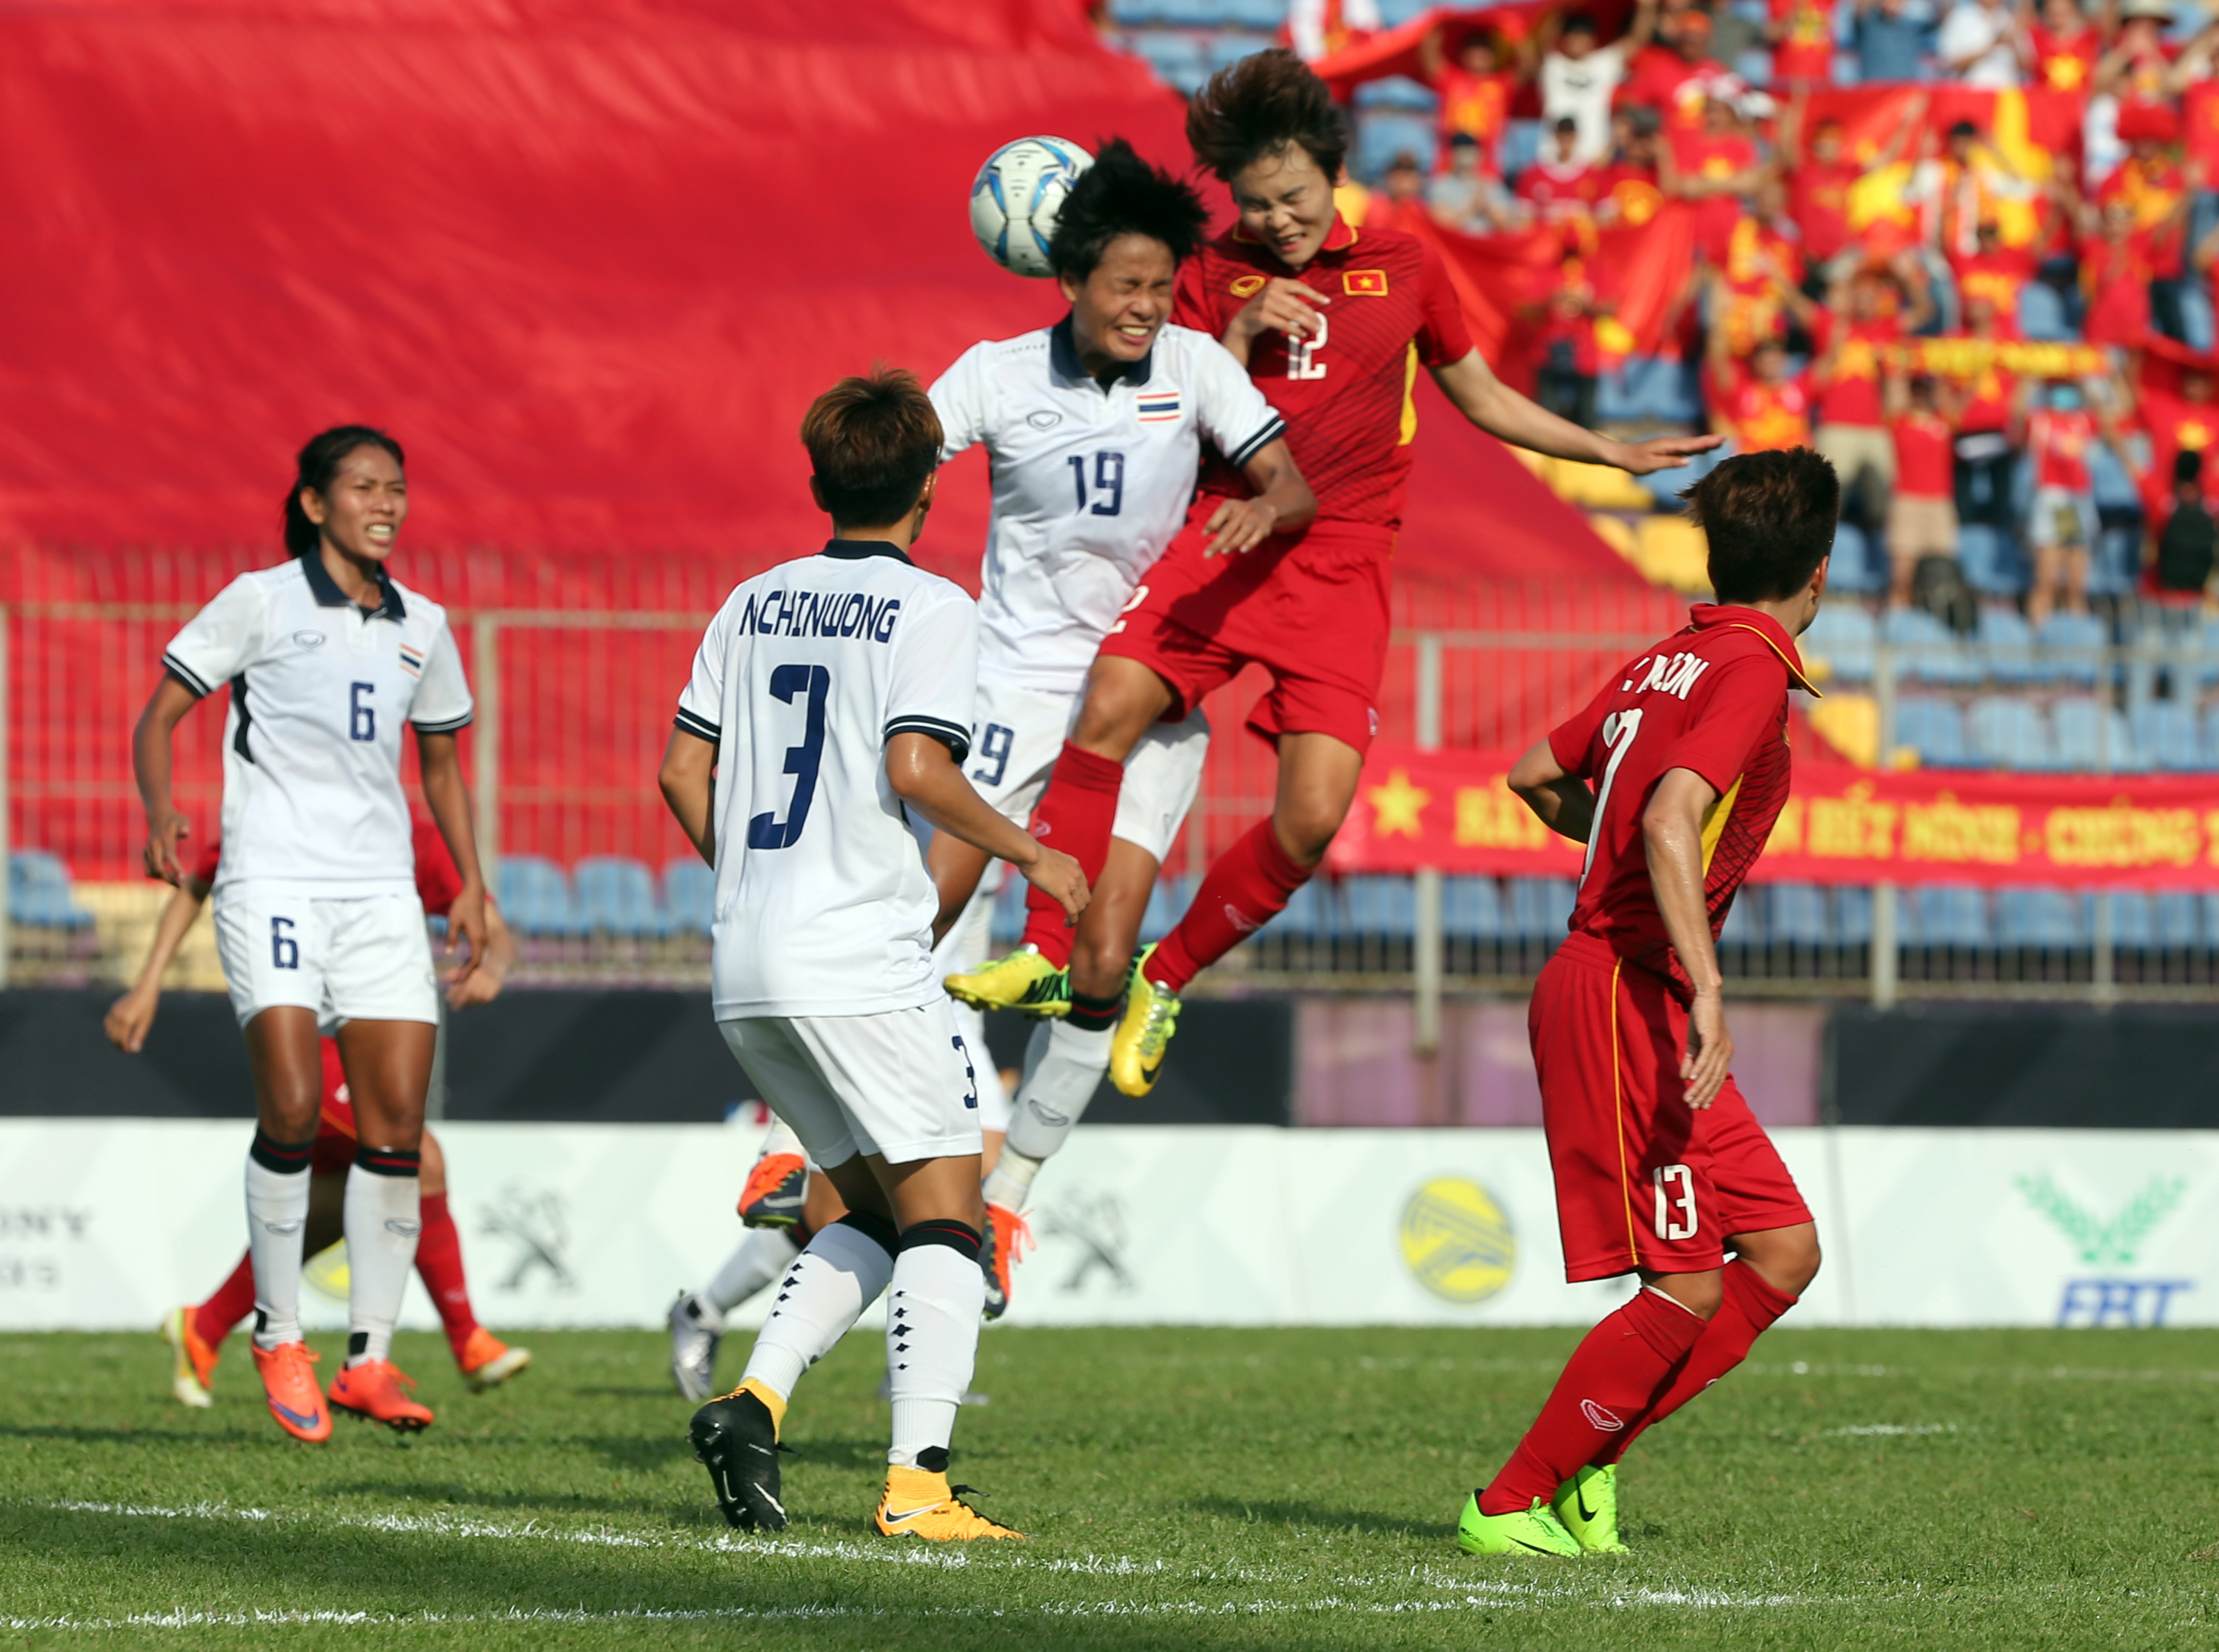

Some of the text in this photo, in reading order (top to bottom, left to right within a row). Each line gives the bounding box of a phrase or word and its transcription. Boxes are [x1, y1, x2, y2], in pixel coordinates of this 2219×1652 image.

[1287, 311, 1328, 381] 12
[1067, 452, 1124, 516] 19
[350, 681, 375, 742] 6
[747, 664, 830, 850] 3
[973, 721, 1015, 786] 9
[271, 916, 299, 969] 6
[952, 1035, 978, 1109] 3
[1652, 1163, 1698, 1241] 13
